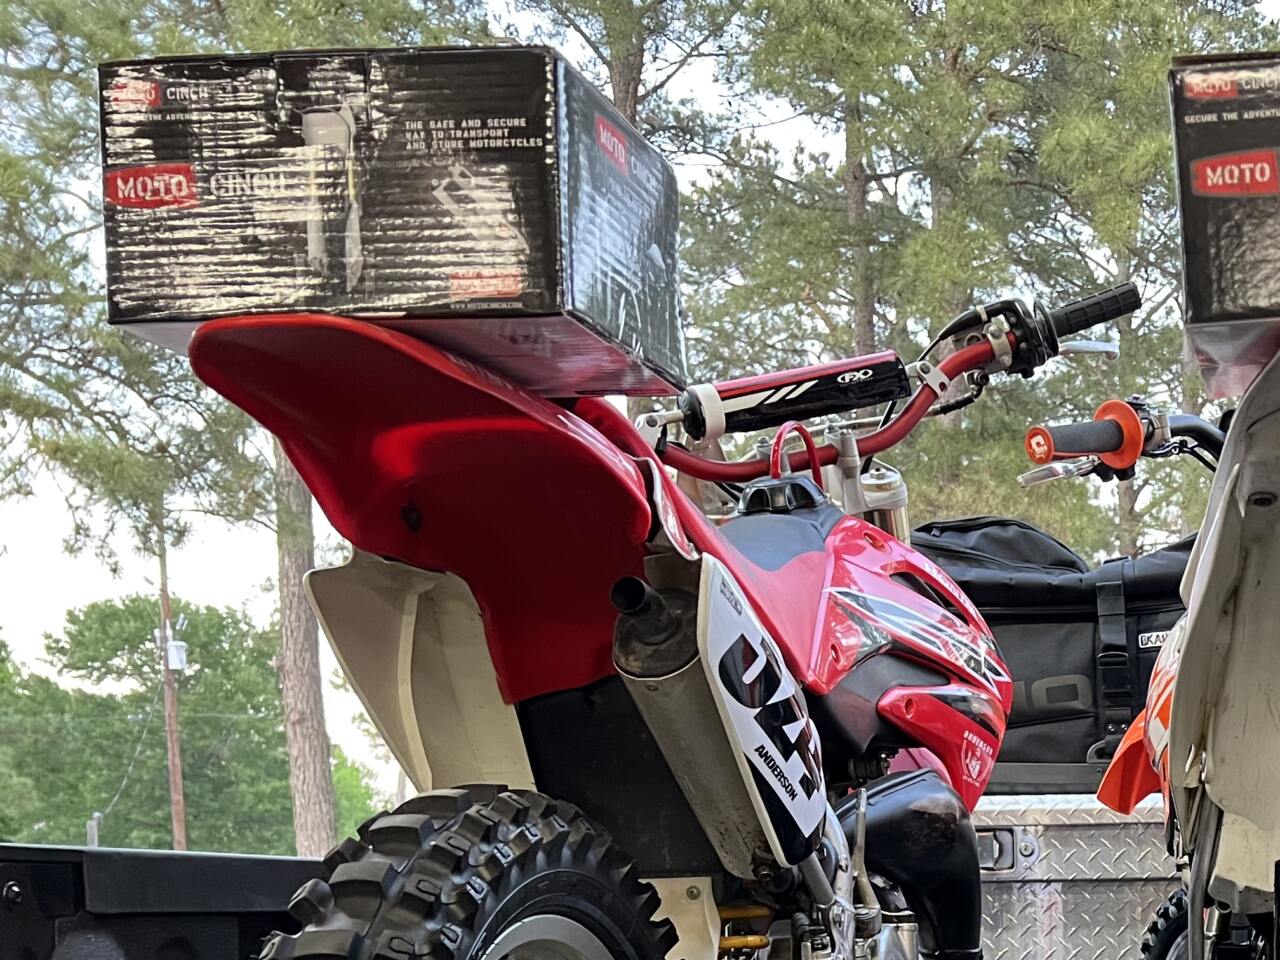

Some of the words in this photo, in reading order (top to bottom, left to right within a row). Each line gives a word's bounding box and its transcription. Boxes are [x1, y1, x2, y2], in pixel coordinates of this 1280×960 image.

[405, 120, 423, 129] THE
[429, 119, 455, 129] SAFE
[461, 118, 481, 128] AND
[487, 118, 527, 127] SECURE
[1184, 113, 1218, 124] SECURE
[1222, 111, 1238, 121] THE
[405, 131, 425, 140] WAY
[431, 130, 444, 139] TO
[450, 128, 510, 138] TRANSPORT
[599, 122, 626, 164] MOTO
[406, 141, 426, 150] AND
[431, 139, 464, 150] STORE
[469, 138, 543, 149] MOTORCYCLES
[1206, 162, 1271, 187] MOTO
[117, 174, 189, 199] MOTO
[754, 744, 799, 802] ANDERSON
